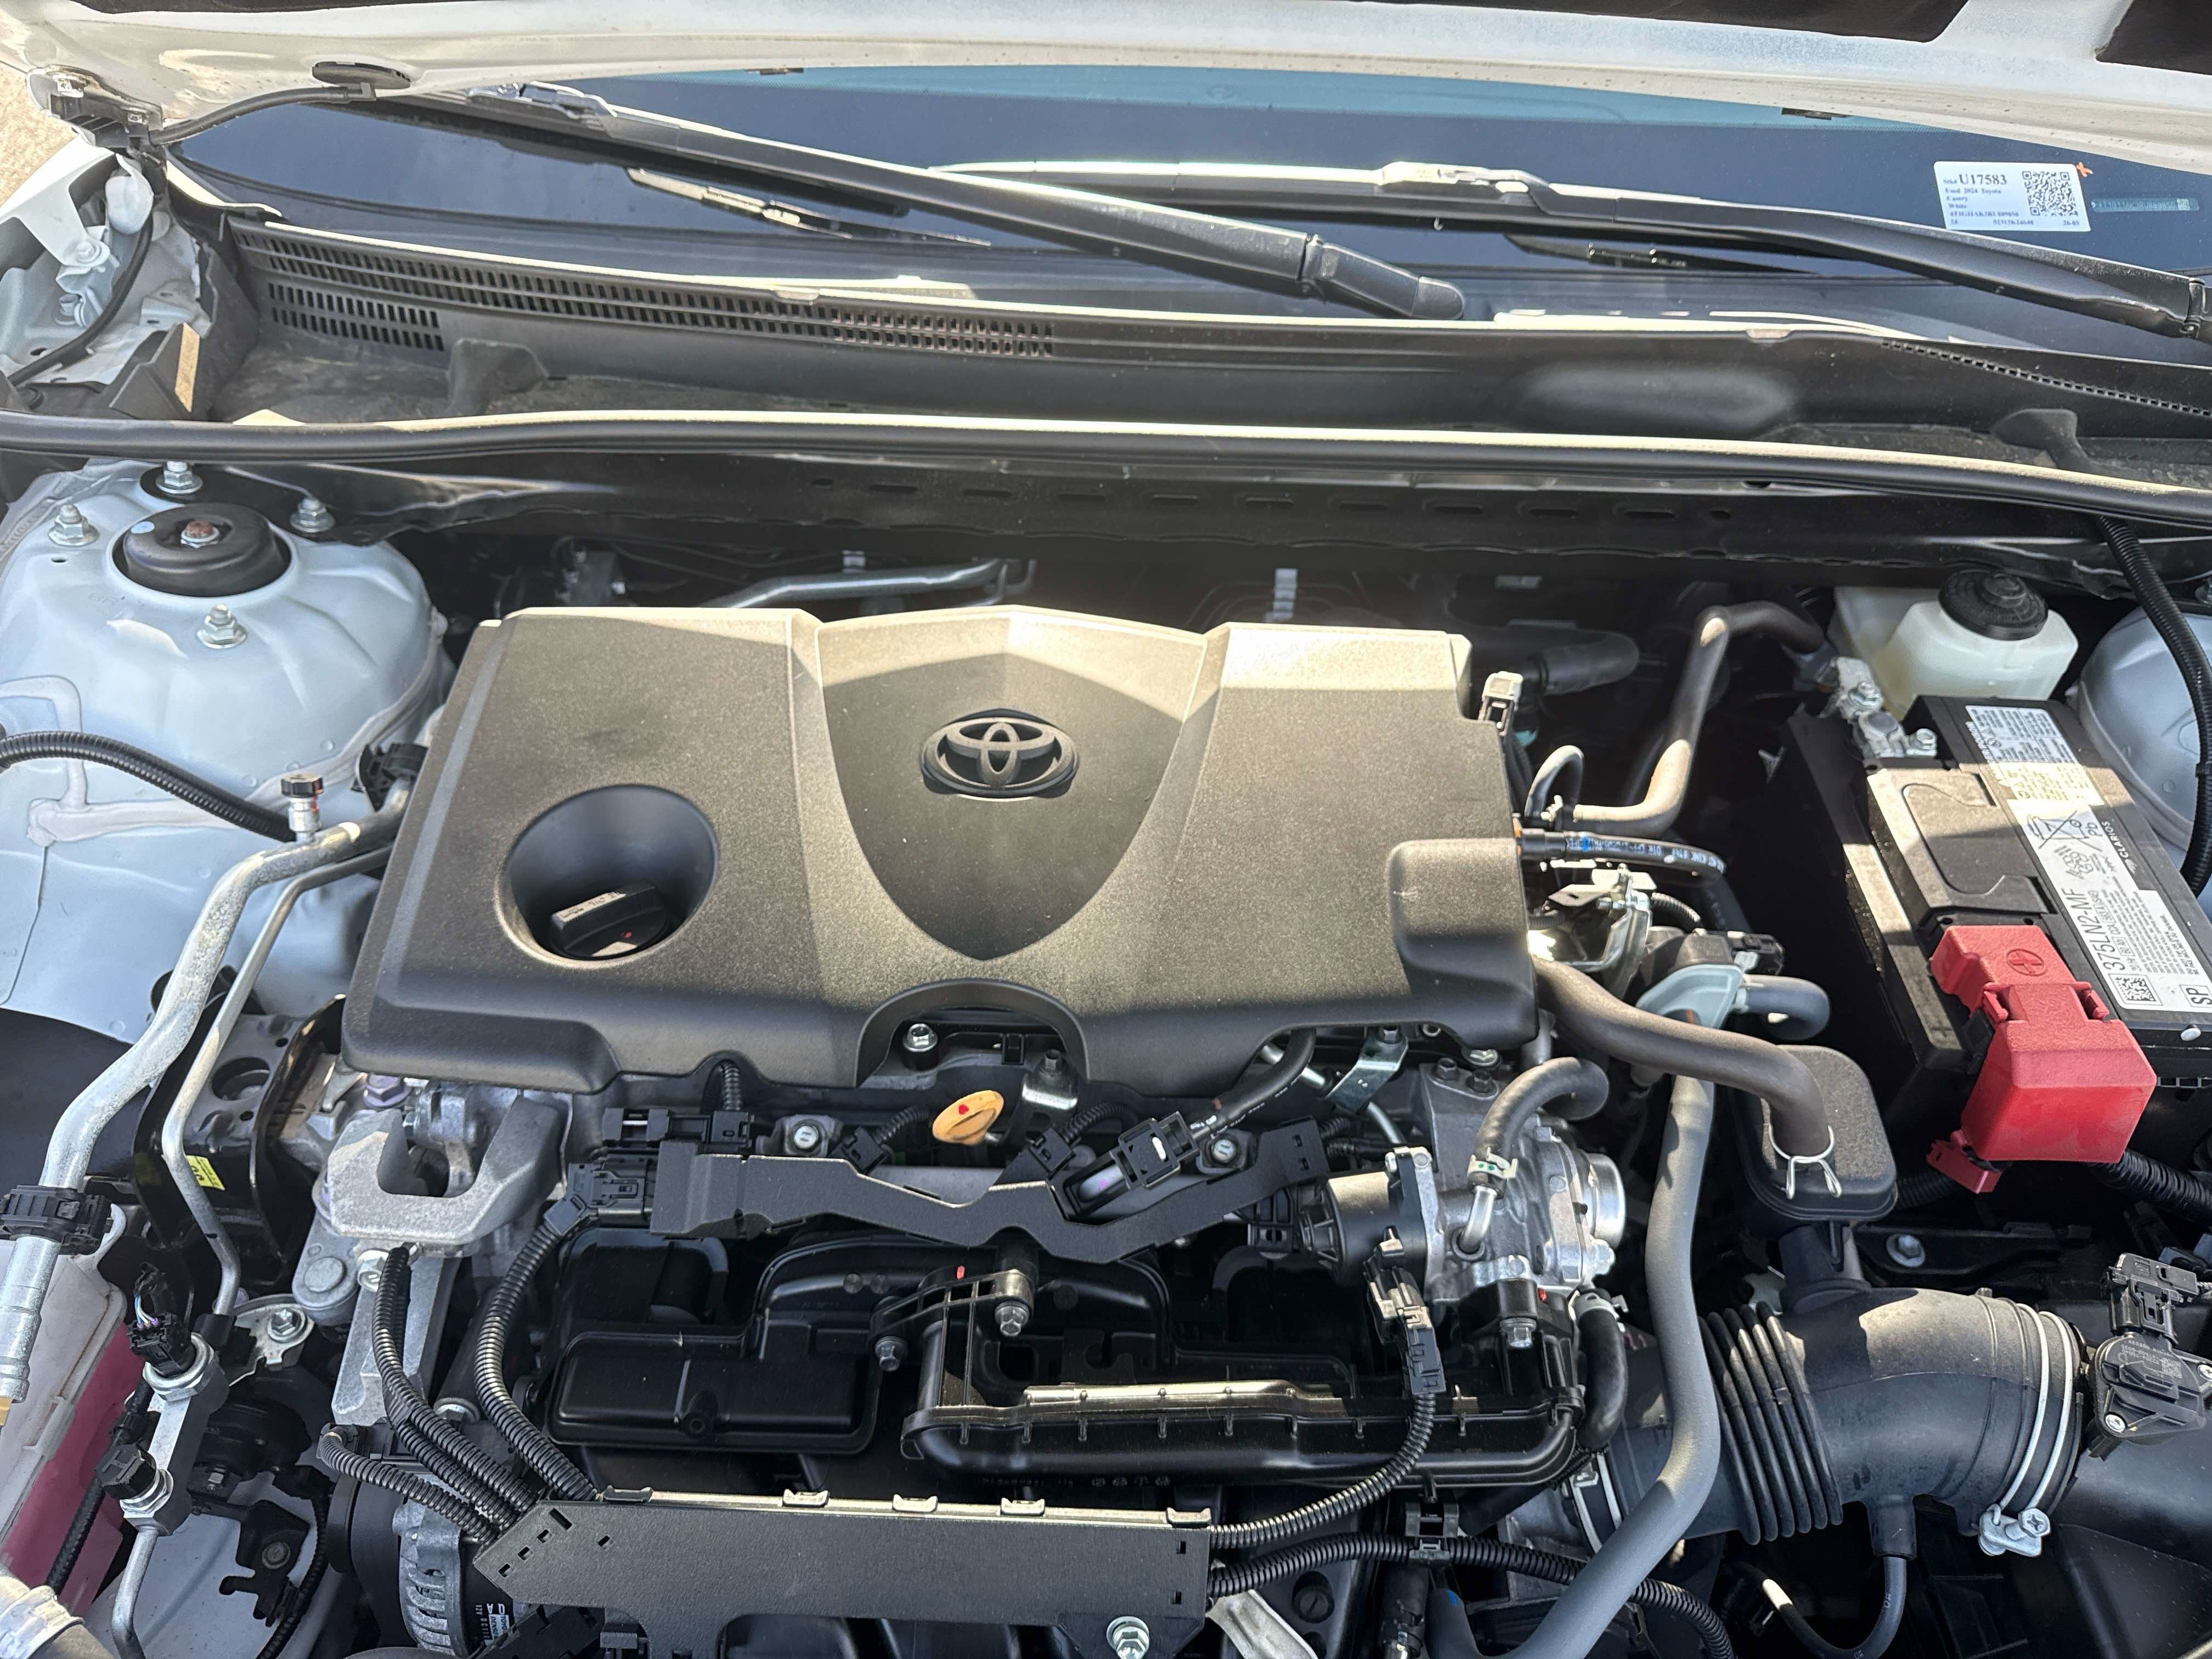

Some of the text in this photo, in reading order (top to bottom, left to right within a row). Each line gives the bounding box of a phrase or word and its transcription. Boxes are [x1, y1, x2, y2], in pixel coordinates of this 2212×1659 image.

[1959, 174, 2007, 185] U17583
[2085, 822, 2102, 837] Pb
[2102, 821, 2129, 858] CLARIOS
[2063, 889, 2125, 970] 375LN2-MF
[2186, 988, 2212, 1005] SP
[490, 1616, 499, 1635] DENSO
